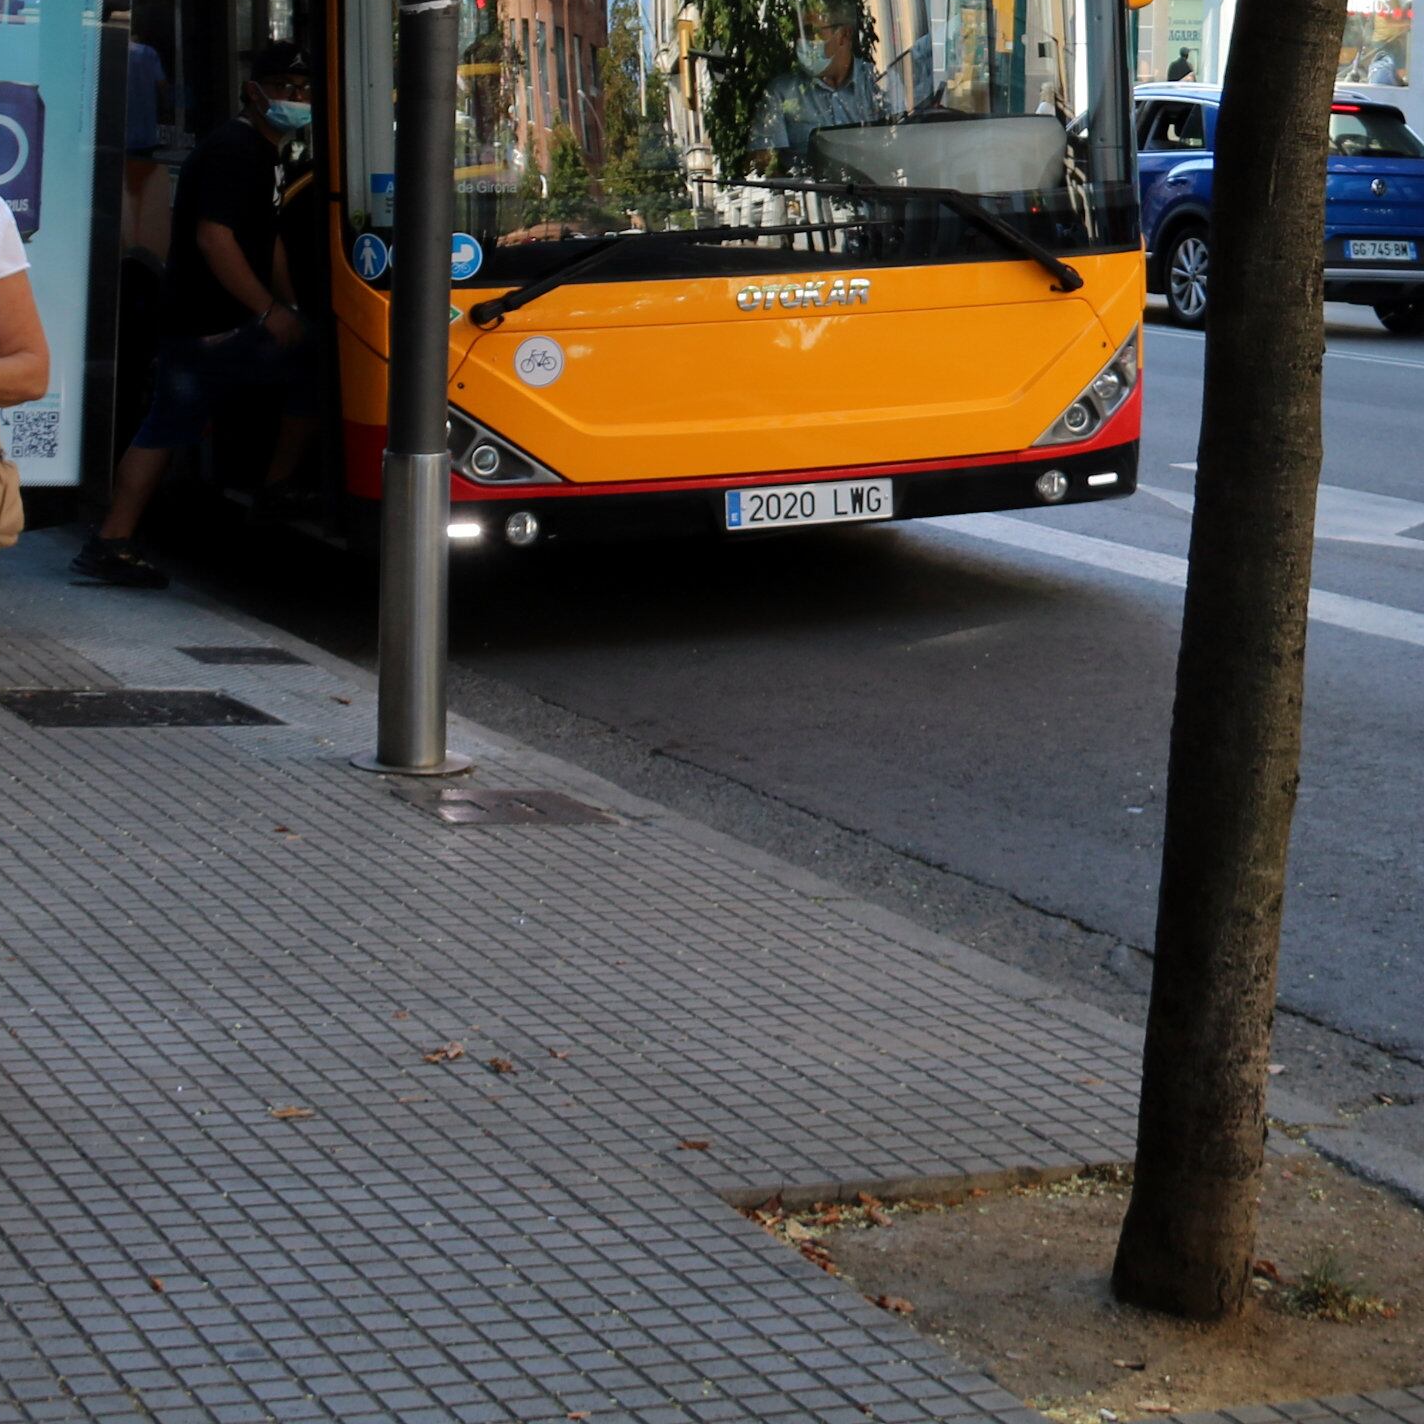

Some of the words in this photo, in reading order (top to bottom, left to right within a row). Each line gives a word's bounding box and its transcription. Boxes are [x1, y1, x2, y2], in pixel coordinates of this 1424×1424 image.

[456, 179, 473, 194] de
[475, 179, 517, 195] Girona
[736, 278, 871, 312] OTOKAR
[748, 490, 816, 522] 2020
[833, 485, 882, 516] LWG
